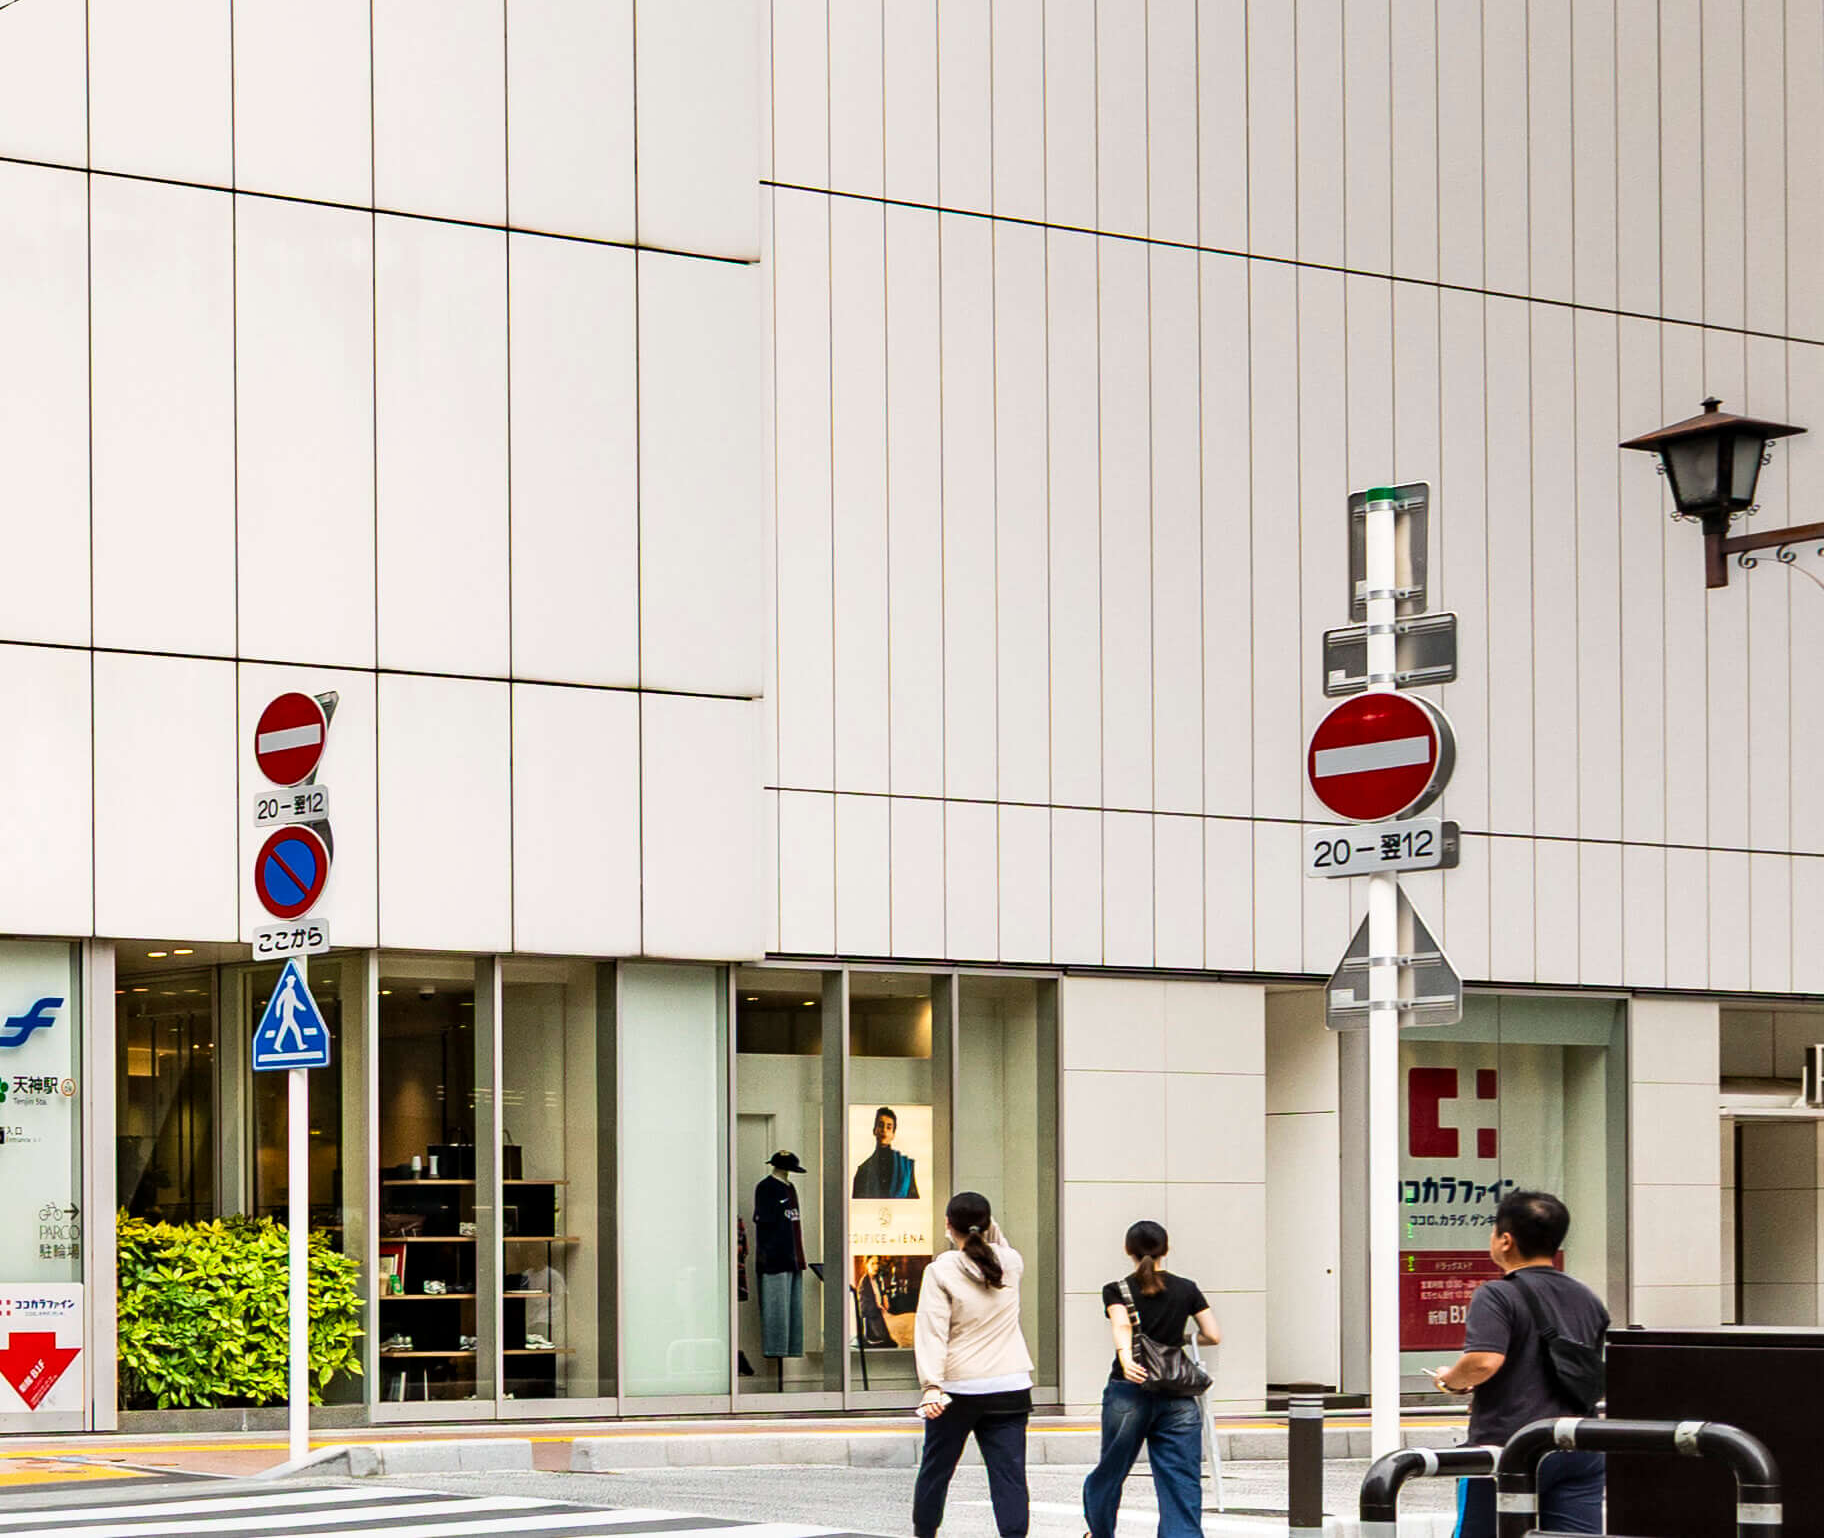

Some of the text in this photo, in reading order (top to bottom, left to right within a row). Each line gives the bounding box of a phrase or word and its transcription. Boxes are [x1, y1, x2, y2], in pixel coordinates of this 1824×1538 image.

[259, 927, 323, 953] ここから
[13, 1076, 59, 1095] 天神駅
[1399, 1176, 1521, 1205] コカラファイン
[39, 1225, 80, 1240] PARCO
[39, 1243, 80, 1259] 駐輪場
[15, 1299, 75, 1310] ココカラファイン
